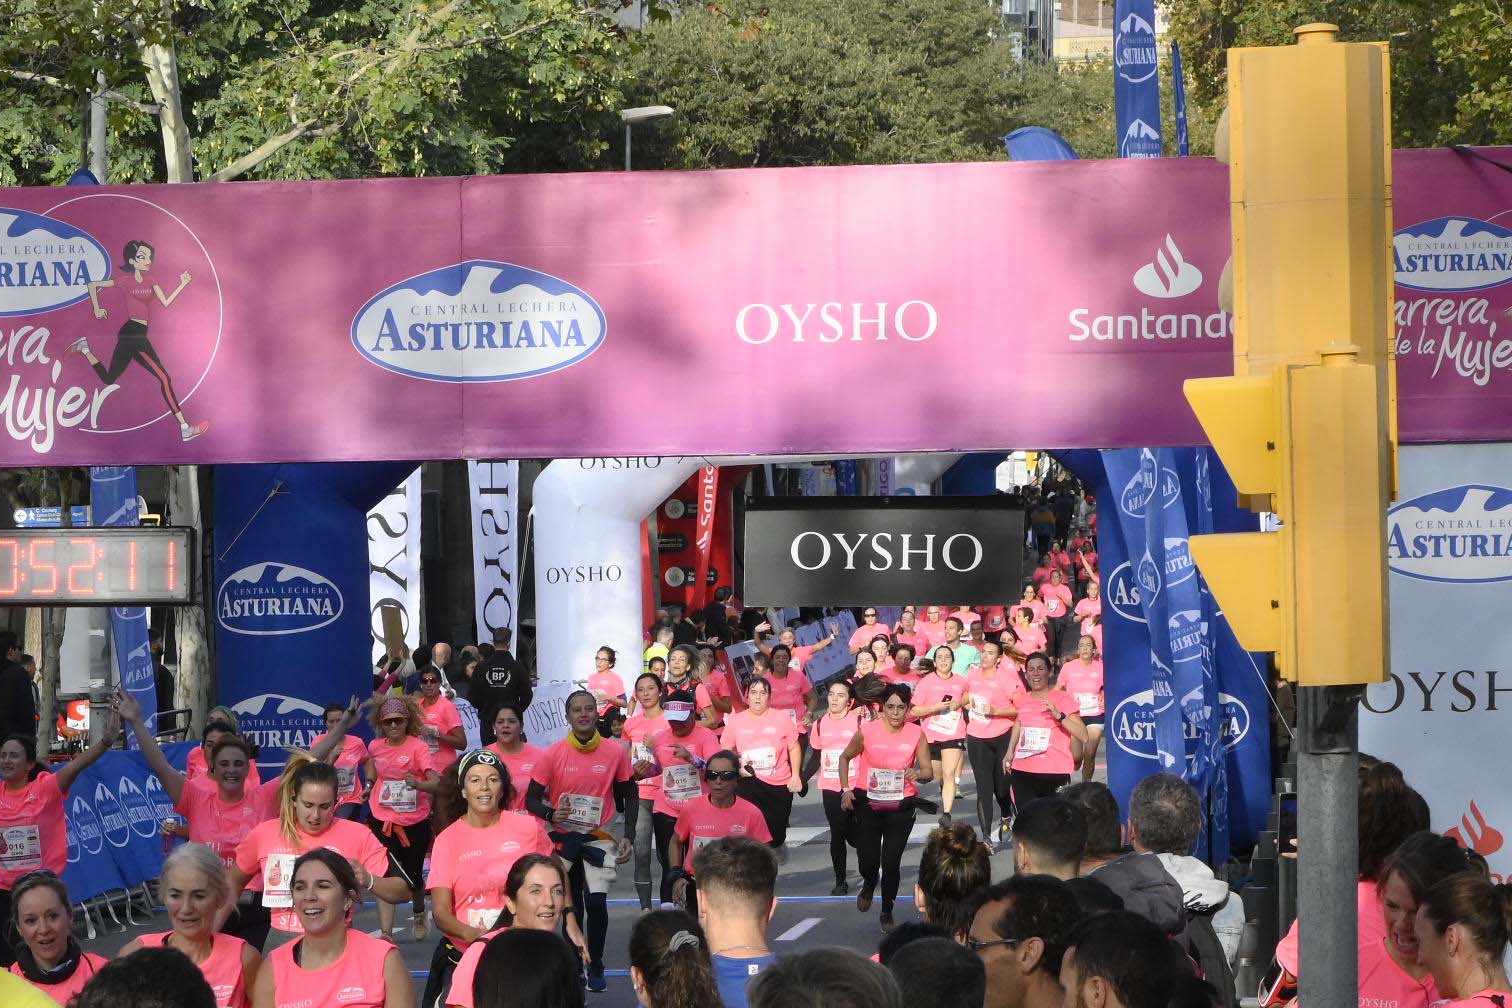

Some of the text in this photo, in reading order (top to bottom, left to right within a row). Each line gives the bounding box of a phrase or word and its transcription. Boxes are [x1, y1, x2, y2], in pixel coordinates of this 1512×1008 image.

[14, 244, 87, 255] LECHERA
[1408, 240, 1460, 251] CENTRAL
[411, 301, 577, 317] CENTRAL LECHERA
[1395, 297, 1488, 328] arrera
[372, 308, 586, 352] ASTURIANA
[735, 300, 939, 345] OYSHO
[1068, 308, 1234, 341] Santand
[1417, 328, 1435, 355] la
[1430, 322, 1512, 387] Muje
[1415, 519, 1483, 529] CENTRAL
[791, 532, 983, 572] OYSHO
[546, 565, 622, 585] OYSHO
[234, 586, 329, 595] CENTRAL LECHERA
[222, 592, 334, 618] ASTURIANA
[492, 672, 505, 681] BP
[1361, 670, 1512, 714] OYSH
[282, 718, 326, 726] LECHER
